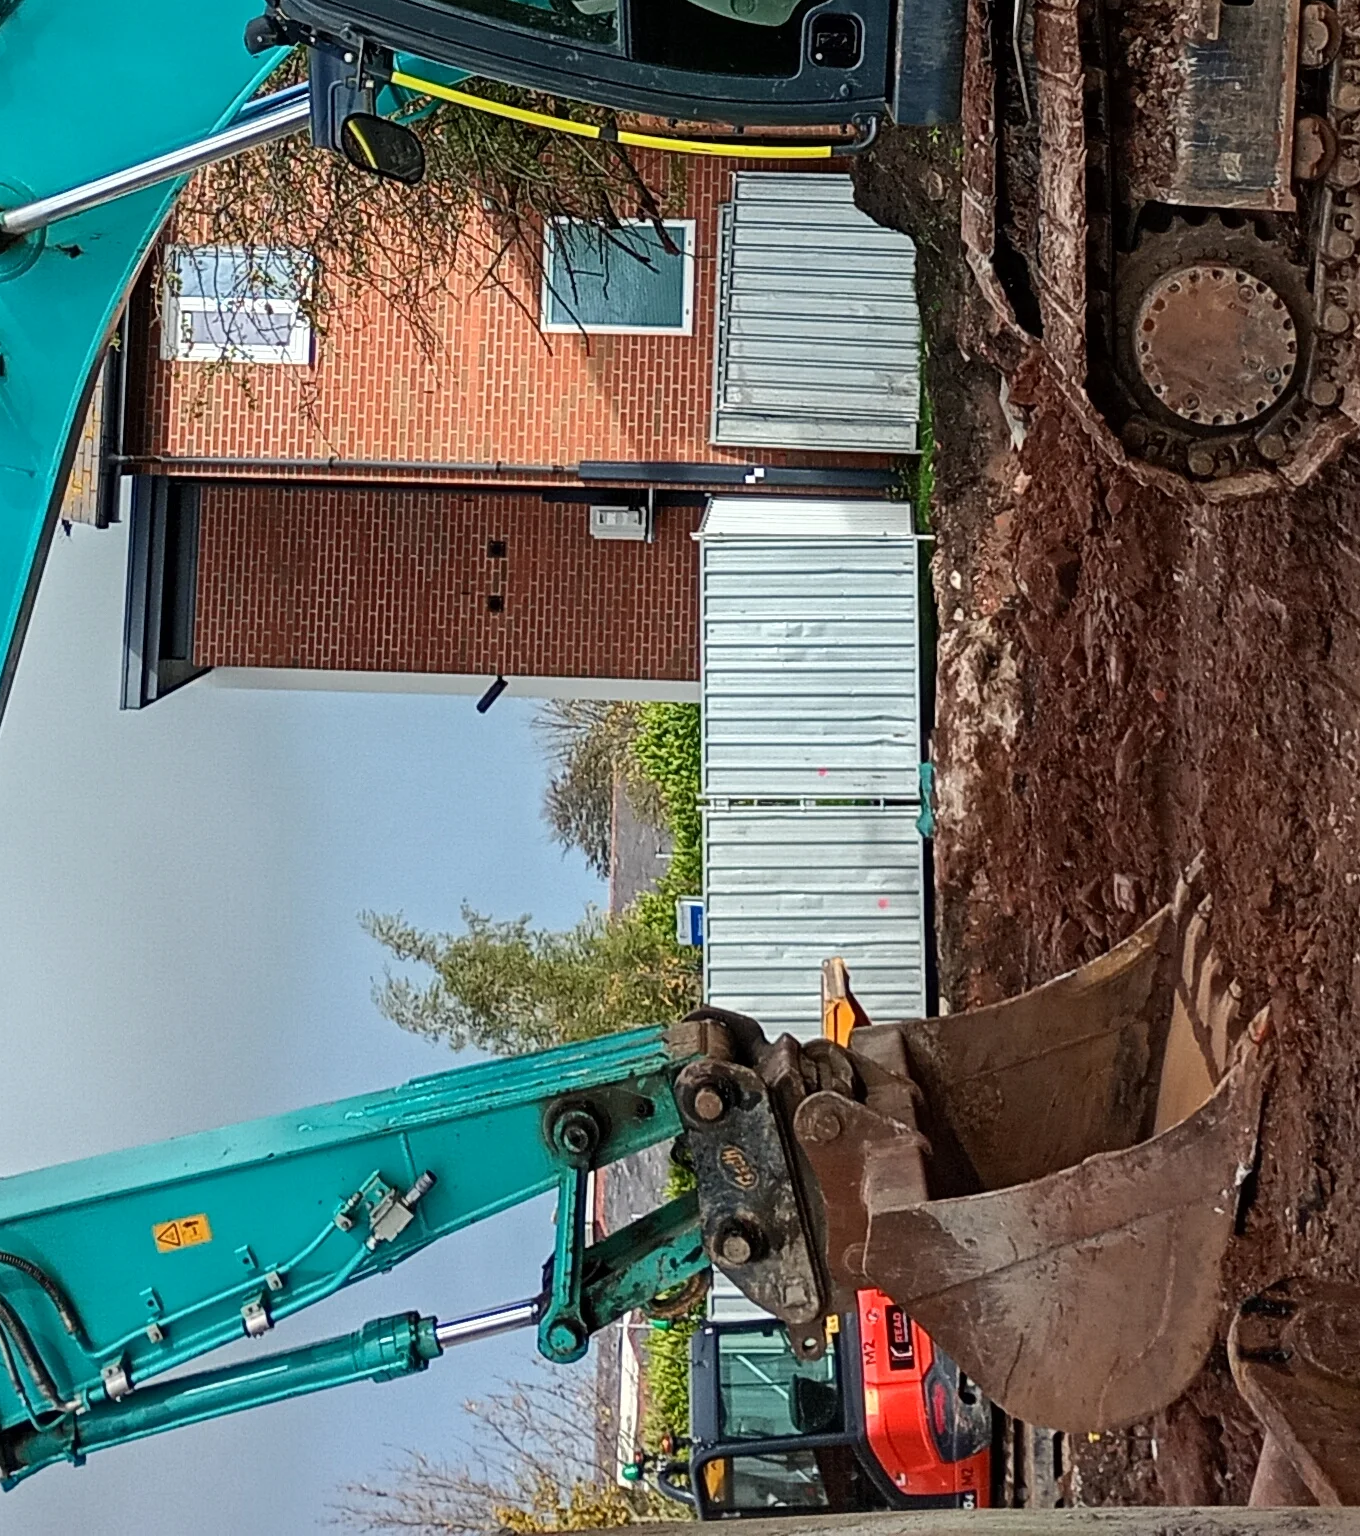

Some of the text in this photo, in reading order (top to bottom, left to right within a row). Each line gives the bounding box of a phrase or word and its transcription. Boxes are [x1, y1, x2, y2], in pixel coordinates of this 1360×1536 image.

[893, 1312, 903, 1343] READ
[863, 1339, 876, 1365] M2
[961, 1467, 973, 1486] M2
